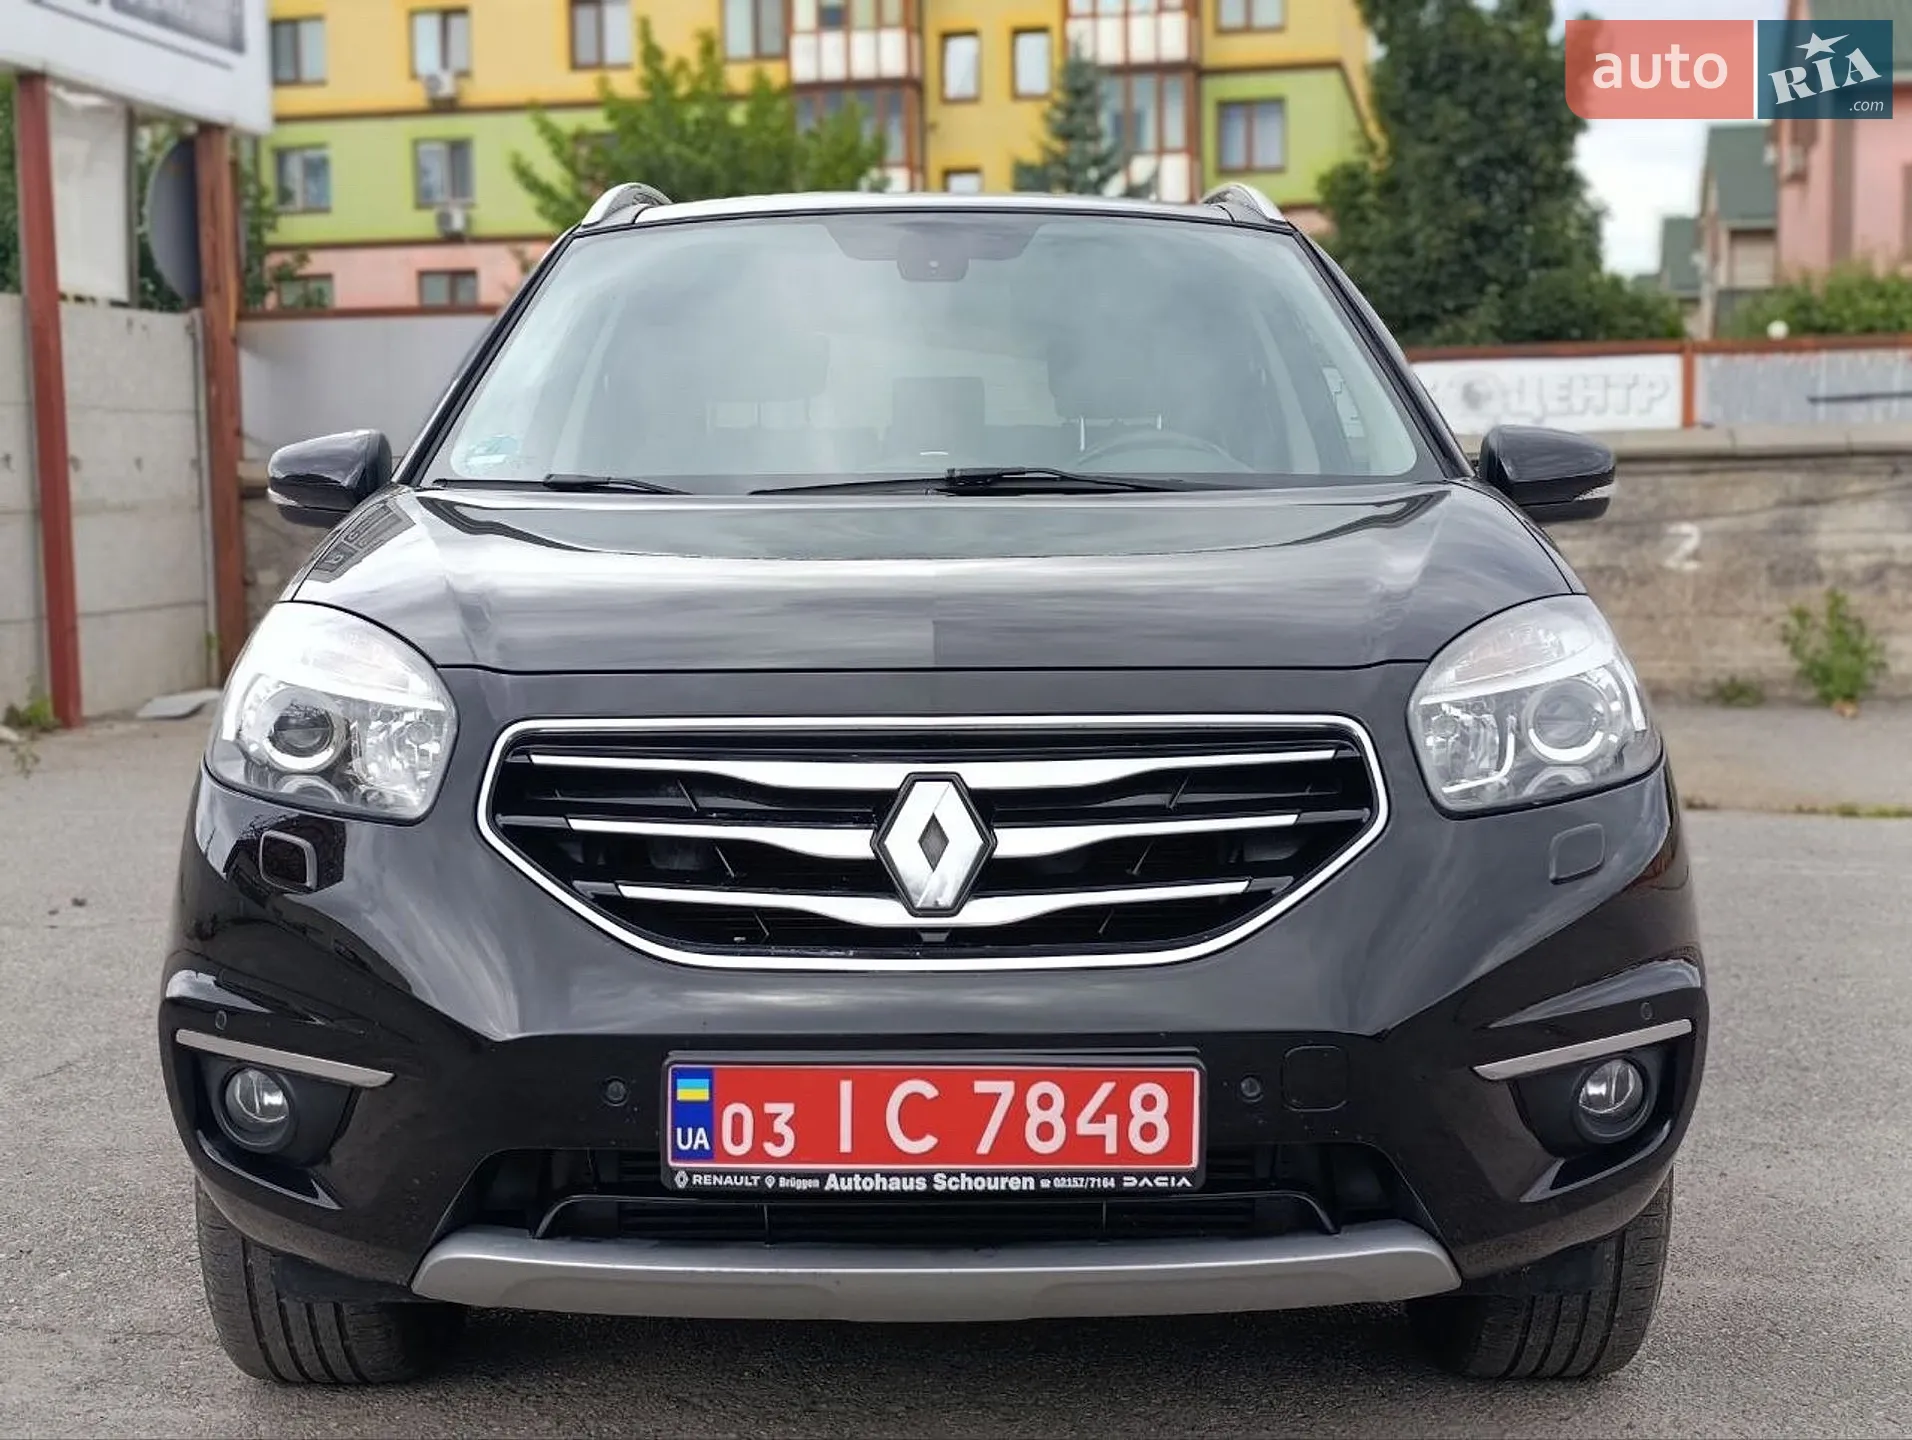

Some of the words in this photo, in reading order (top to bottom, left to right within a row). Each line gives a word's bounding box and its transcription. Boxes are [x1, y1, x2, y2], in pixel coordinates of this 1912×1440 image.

[721, 1102, 796, 1158] 03
[973, 1080, 1171, 1156] 7848
[676, 1126, 711, 1151] UA
[691, 1174, 760, 1187] RENAULT
[778, 1176, 820, 1191] Brüggen
[824, 1173, 928, 1191] Autohaus
[933, 1172, 1035, 1191] Schouren
[1122, 1176, 1193, 1188] DACIA
